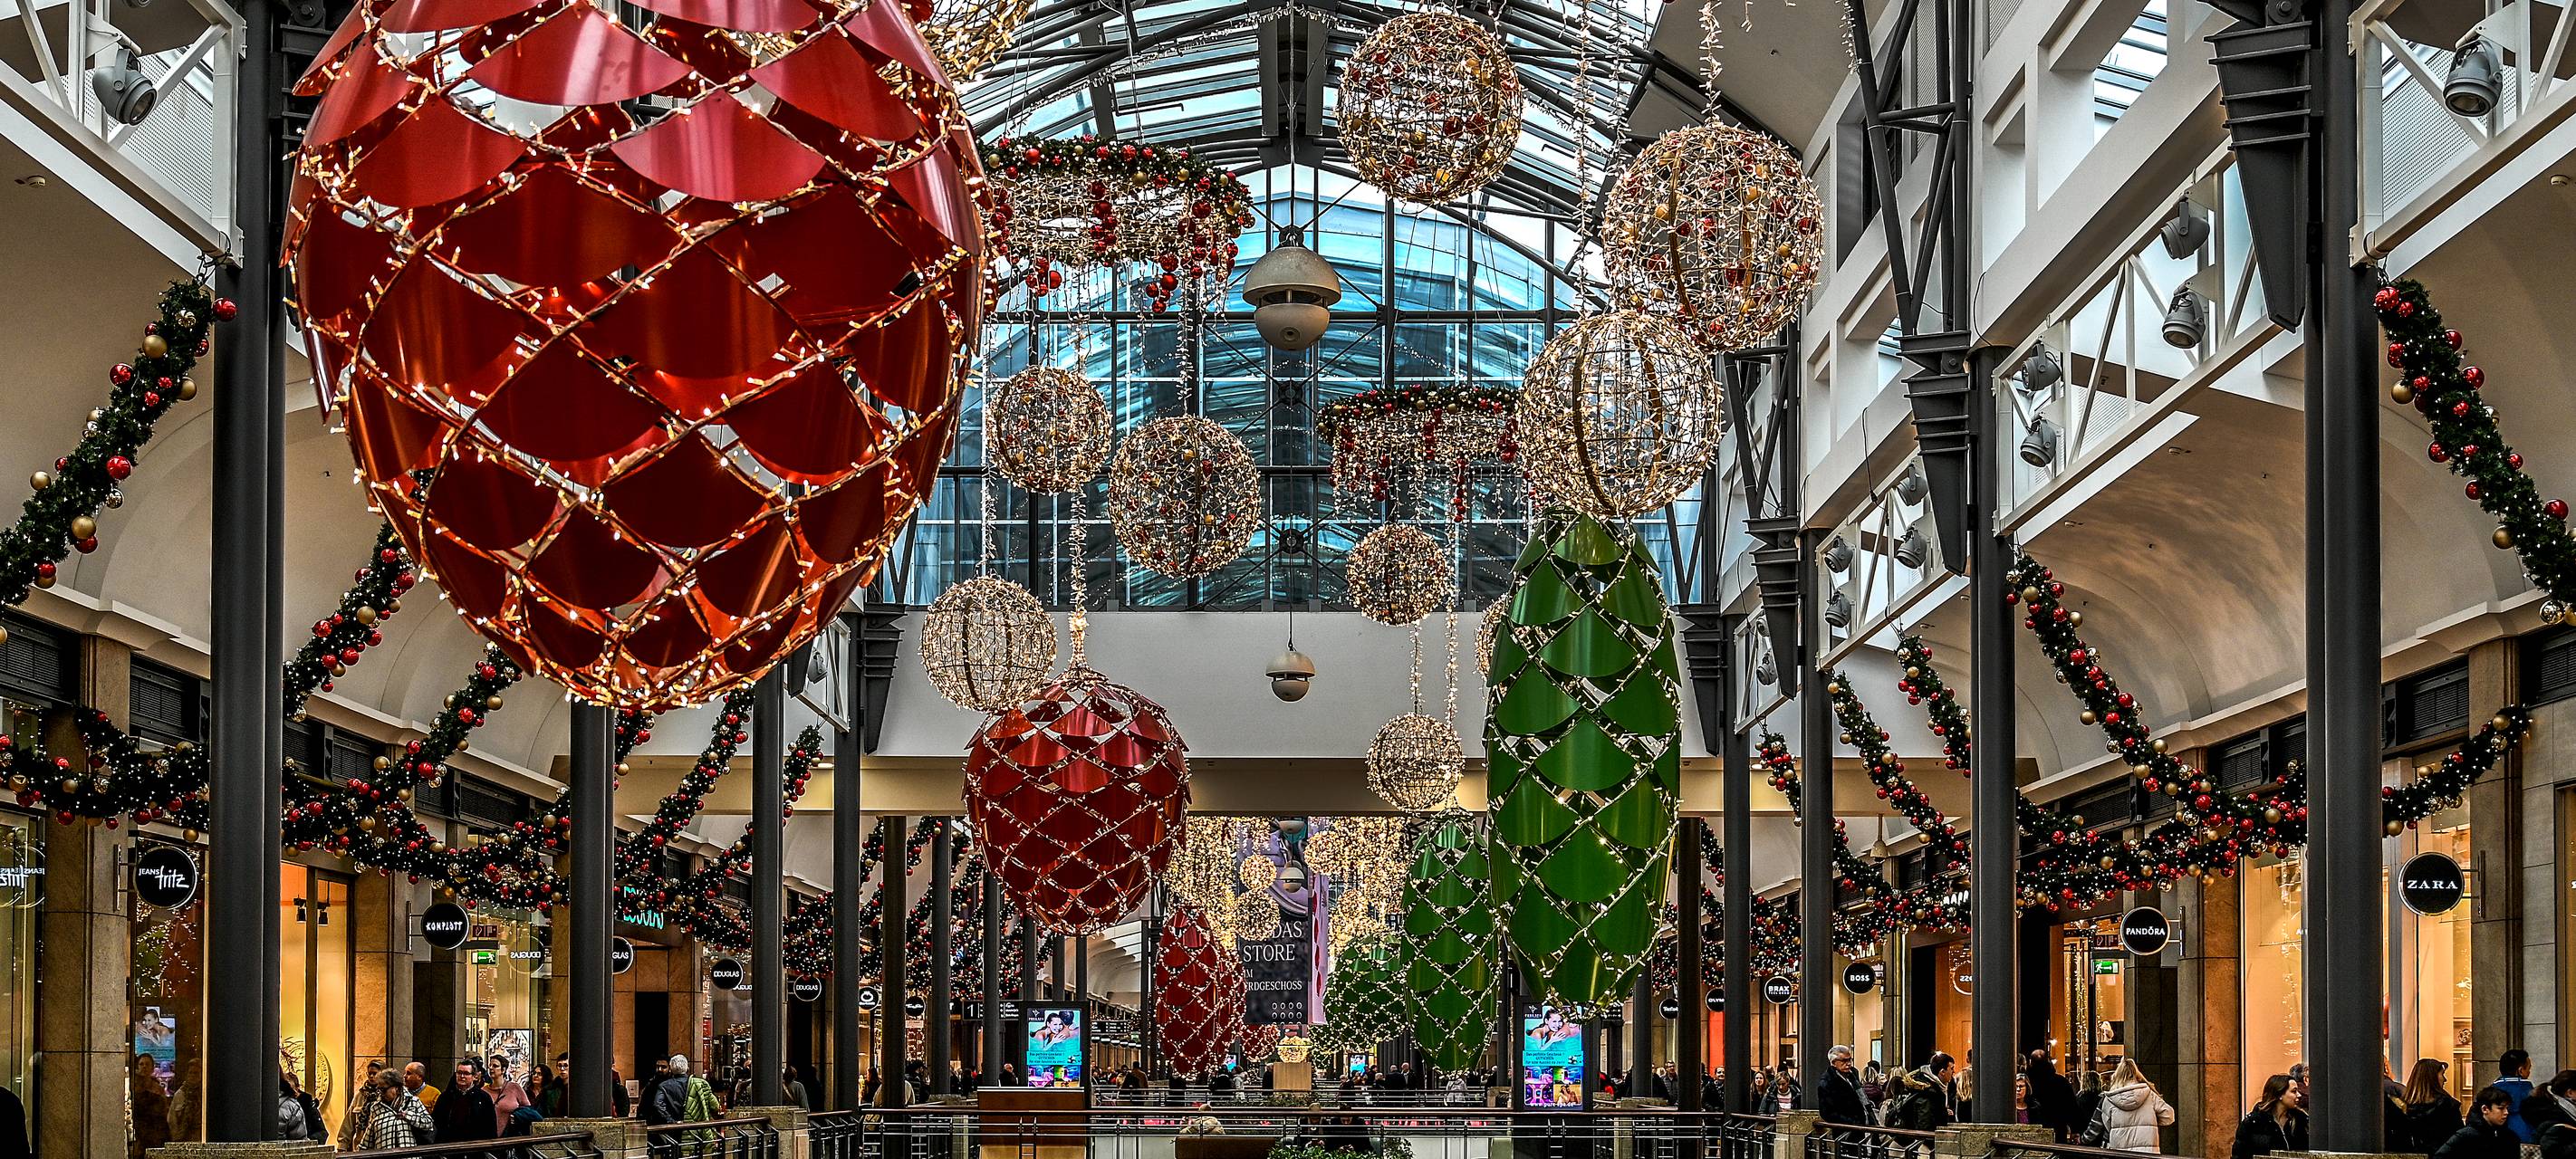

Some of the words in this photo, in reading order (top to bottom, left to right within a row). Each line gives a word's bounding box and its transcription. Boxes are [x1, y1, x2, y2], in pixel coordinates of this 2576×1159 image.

[139, 867, 160, 876] JEANS
[154, 865, 190, 890] fritz
[2407, 879, 2458, 889] ZARA
[1272, 921, 1302, 938] DAS
[2126, 925, 2166, 935] PANDORA
[611, 952, 630, 960] GLAS
[1243, 943, 1295, 962] STORE
[966, 1003, 974, 1017] 1
